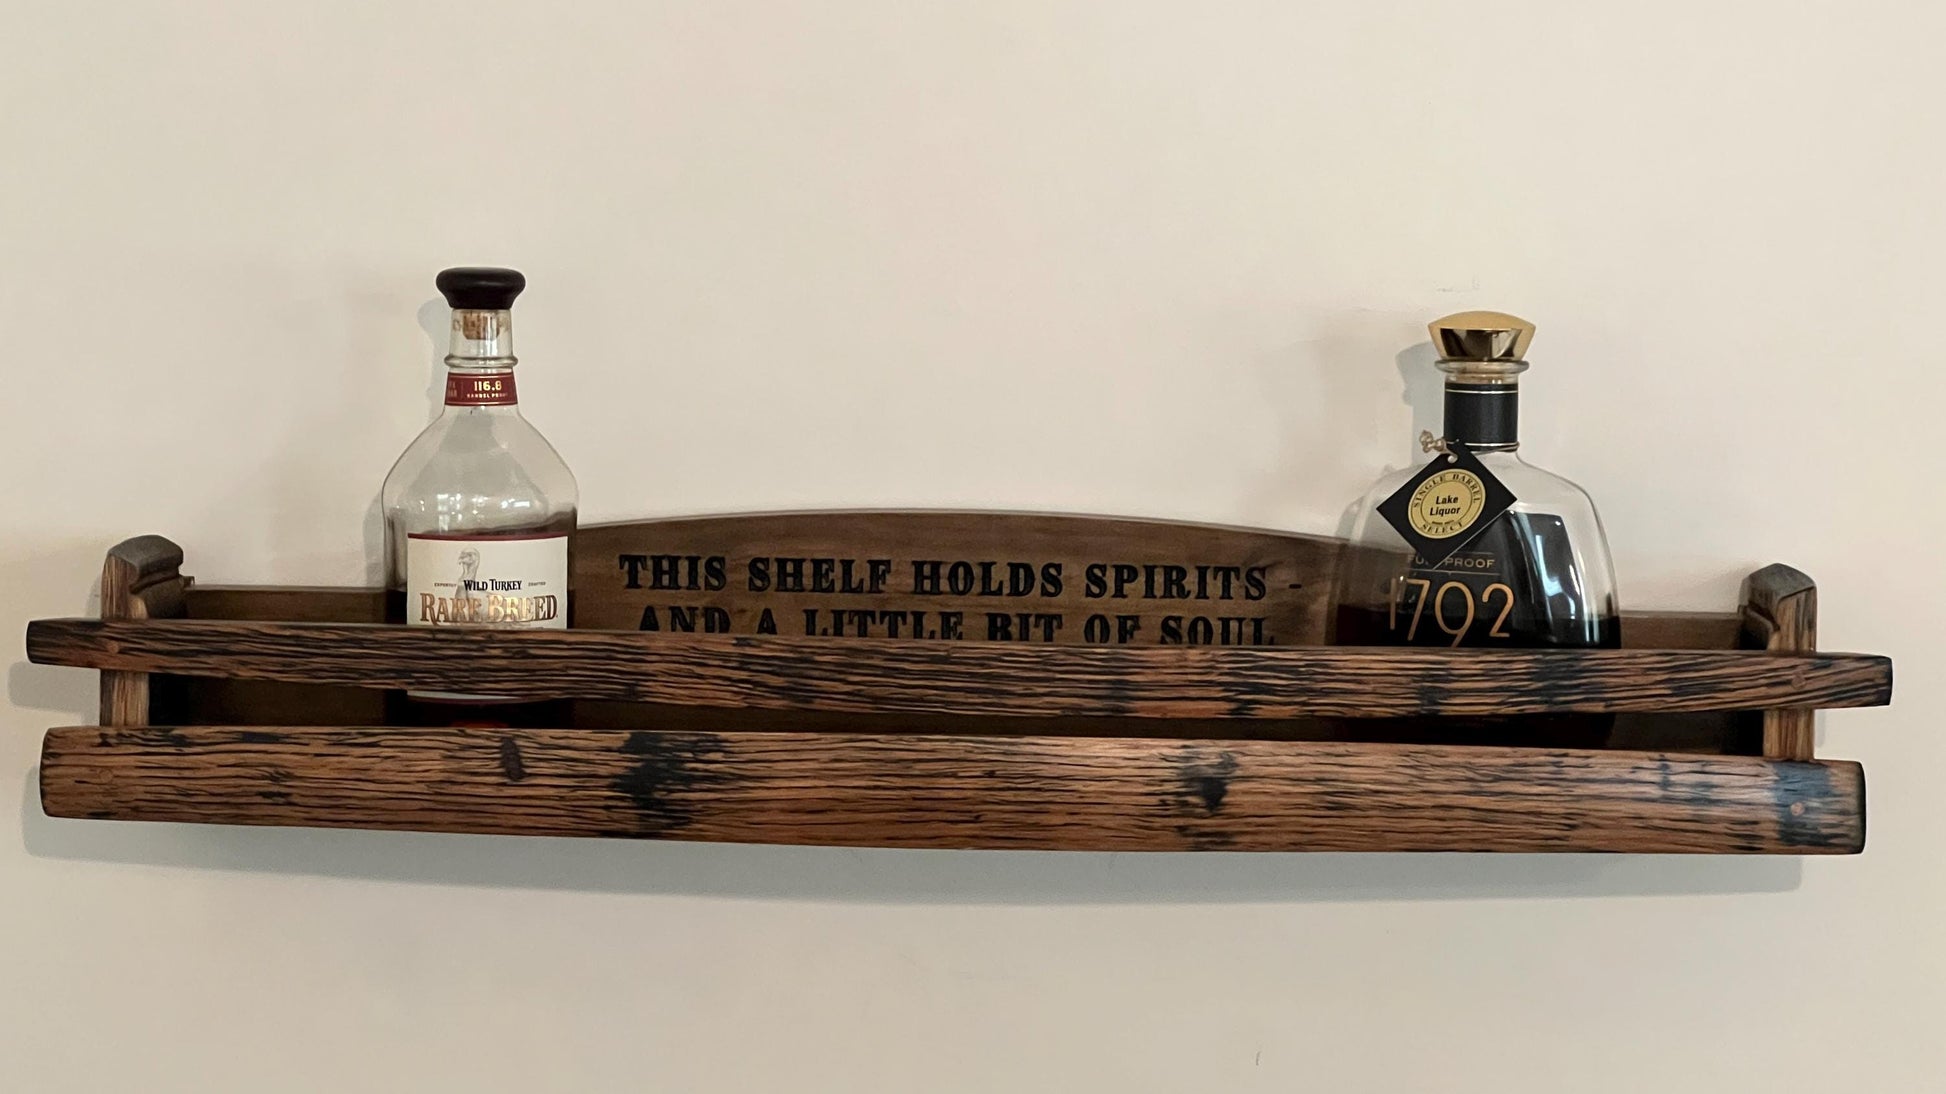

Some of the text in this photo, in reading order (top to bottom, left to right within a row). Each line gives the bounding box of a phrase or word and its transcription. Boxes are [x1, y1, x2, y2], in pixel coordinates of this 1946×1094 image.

[474, 380, 502, 391] 116.8
[1414, 473, 1481, 508] SINGLE BARREL
[1435, 495, 1458, 505] Lake
[1429, 506, 1461, 517] Liquor
[1421, 521, 1464, 534] SELECT
[1444, 557, 1495, 568] PROOF
[619, 554, 726, 591] THIS
[748, 557, 891, 594] SHELF
[912, 560, 1063, 598] HOLDS
[1085, 563, 1267, 600] SPIRITS
[463, 579, 488, 591] WILD
[489, 578, 522, 591] TURKEY
[420, 592, 558, 626] RARE BREED
[1389, 578, 1515, 648] 1792
[639, 605, 1276, 645] AND A LITTLE BIT OF SOUL
